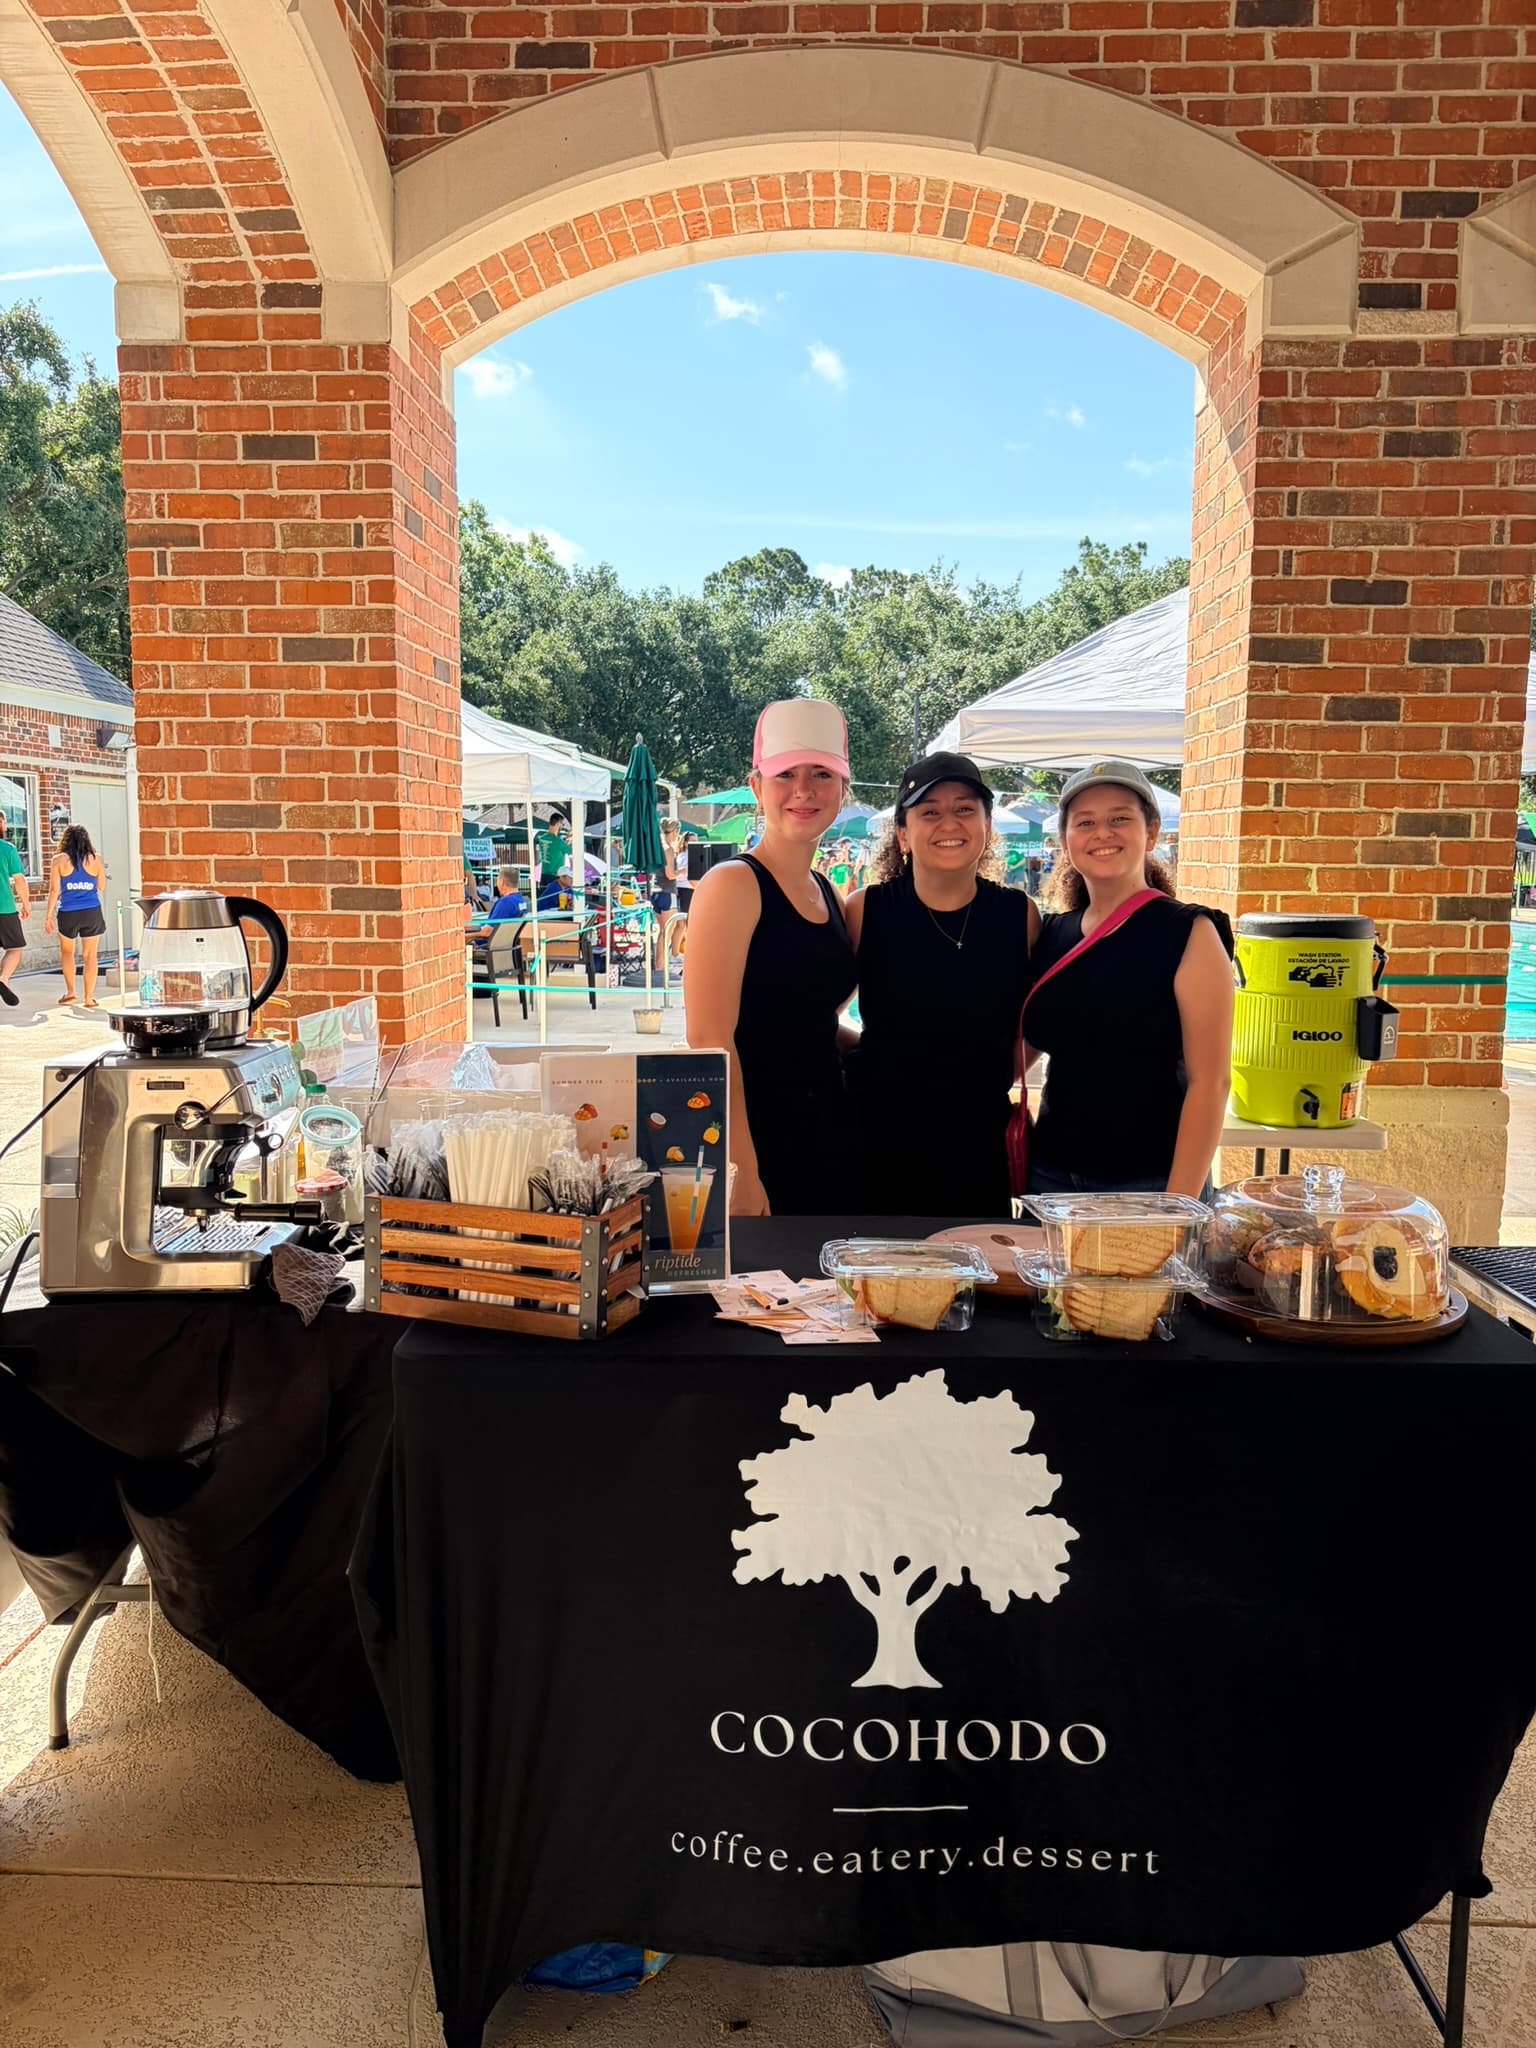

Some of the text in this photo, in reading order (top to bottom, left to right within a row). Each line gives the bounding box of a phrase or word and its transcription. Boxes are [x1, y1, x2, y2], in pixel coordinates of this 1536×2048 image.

[1292, 1030, 1343, 1041] IGLOO
[655, 1253, 701, 1272] riptide
[667, 1269, 718, 1277] REFRESHER
[711, 1711, 1106, 1764] COCOHODO
